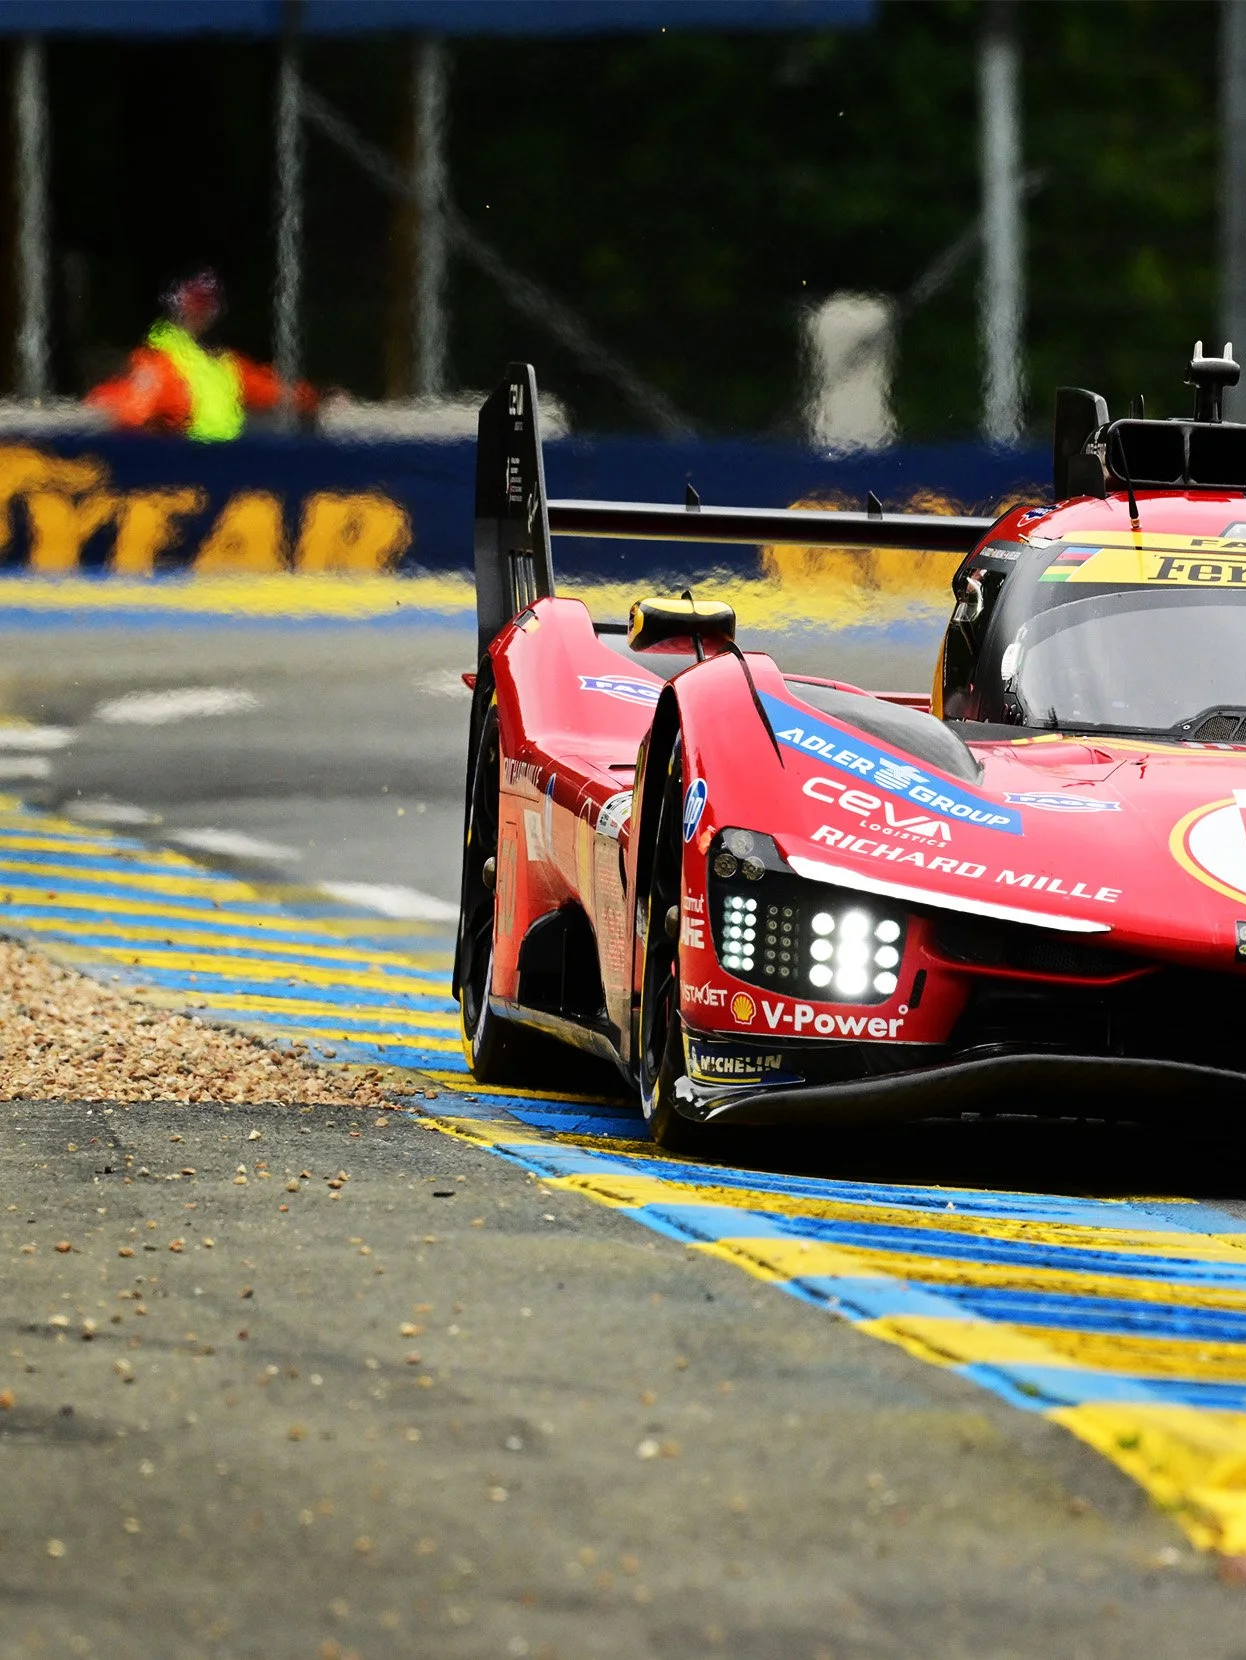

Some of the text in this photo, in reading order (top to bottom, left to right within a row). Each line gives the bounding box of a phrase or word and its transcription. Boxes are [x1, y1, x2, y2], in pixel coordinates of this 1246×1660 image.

[595, 681, 660, 699] FAG
[775, 727, 1011, 829] ADLER GROUP
[859, 820, 948, 849] LOGISTICS
[810, 824, 1124, 903] RICHARD MILLE
[761, 1001, 904, 1038] V-Power
[700, 1054, 783, 1074] MICHELIN
